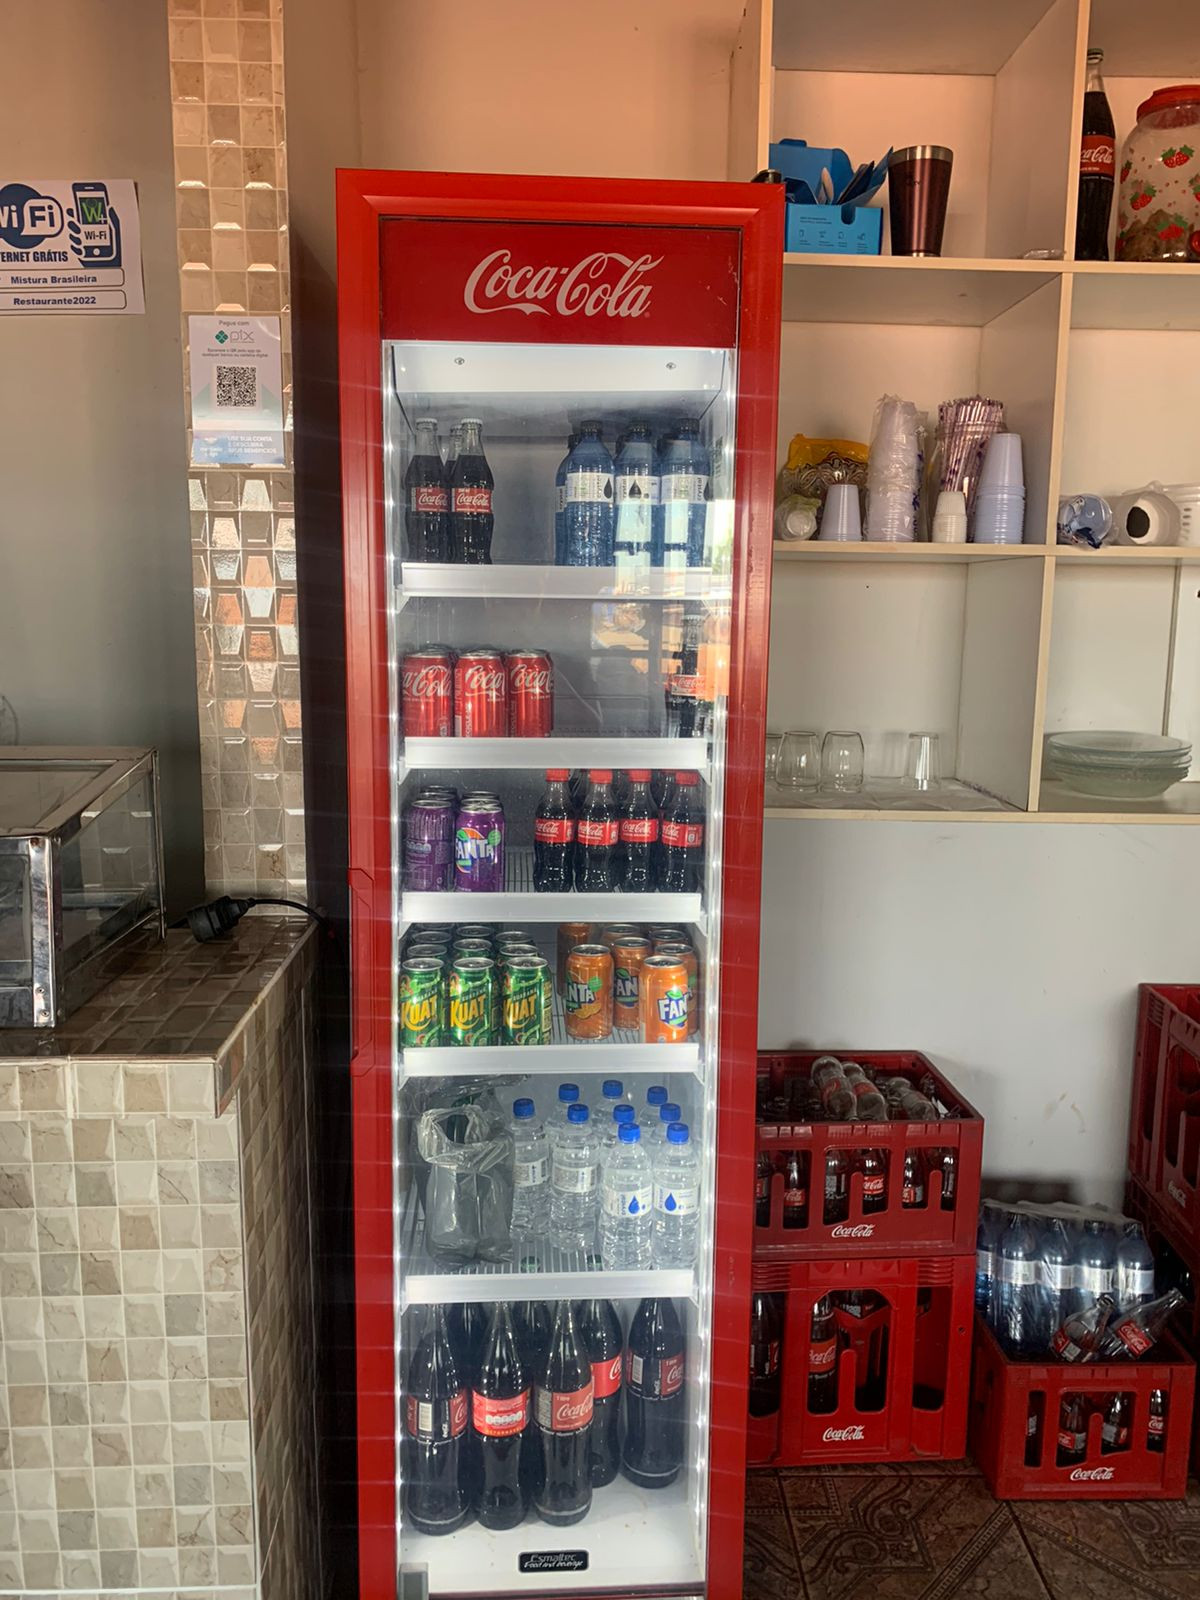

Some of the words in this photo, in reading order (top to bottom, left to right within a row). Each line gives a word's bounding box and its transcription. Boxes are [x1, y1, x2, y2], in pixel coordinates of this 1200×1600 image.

[84, 230, 107, 240] Wi-Fi
[0, 251, 31, 263] ERNET
[32, 249, 68, 263] GRÁTIS
[10, 276, 48, 284] Mistura
[50, 275, 97, 284] Brasileira
[463, 248, 665, 318] Coca-Cola
[13, 296, 97, 305] Restaurante2022
[230, 329, 255, 343] pix
[456, 493, 490, 506] Coca-Cola
[456, 837, 494, 860] ANTA
[401, 995, 438, 1029] KUAT
[450, 994, 486, 1028] KUAT
[504, 994, 537, 1027] KUAT
[831, 1223, 876, 1238] Coca-Cola
[822, 1425, 866, 1442] Coca-Cola
[1070, 1466, 1116, 1481] Coca-Cola
[530, 1553, 577, 1563] Esmaltec
